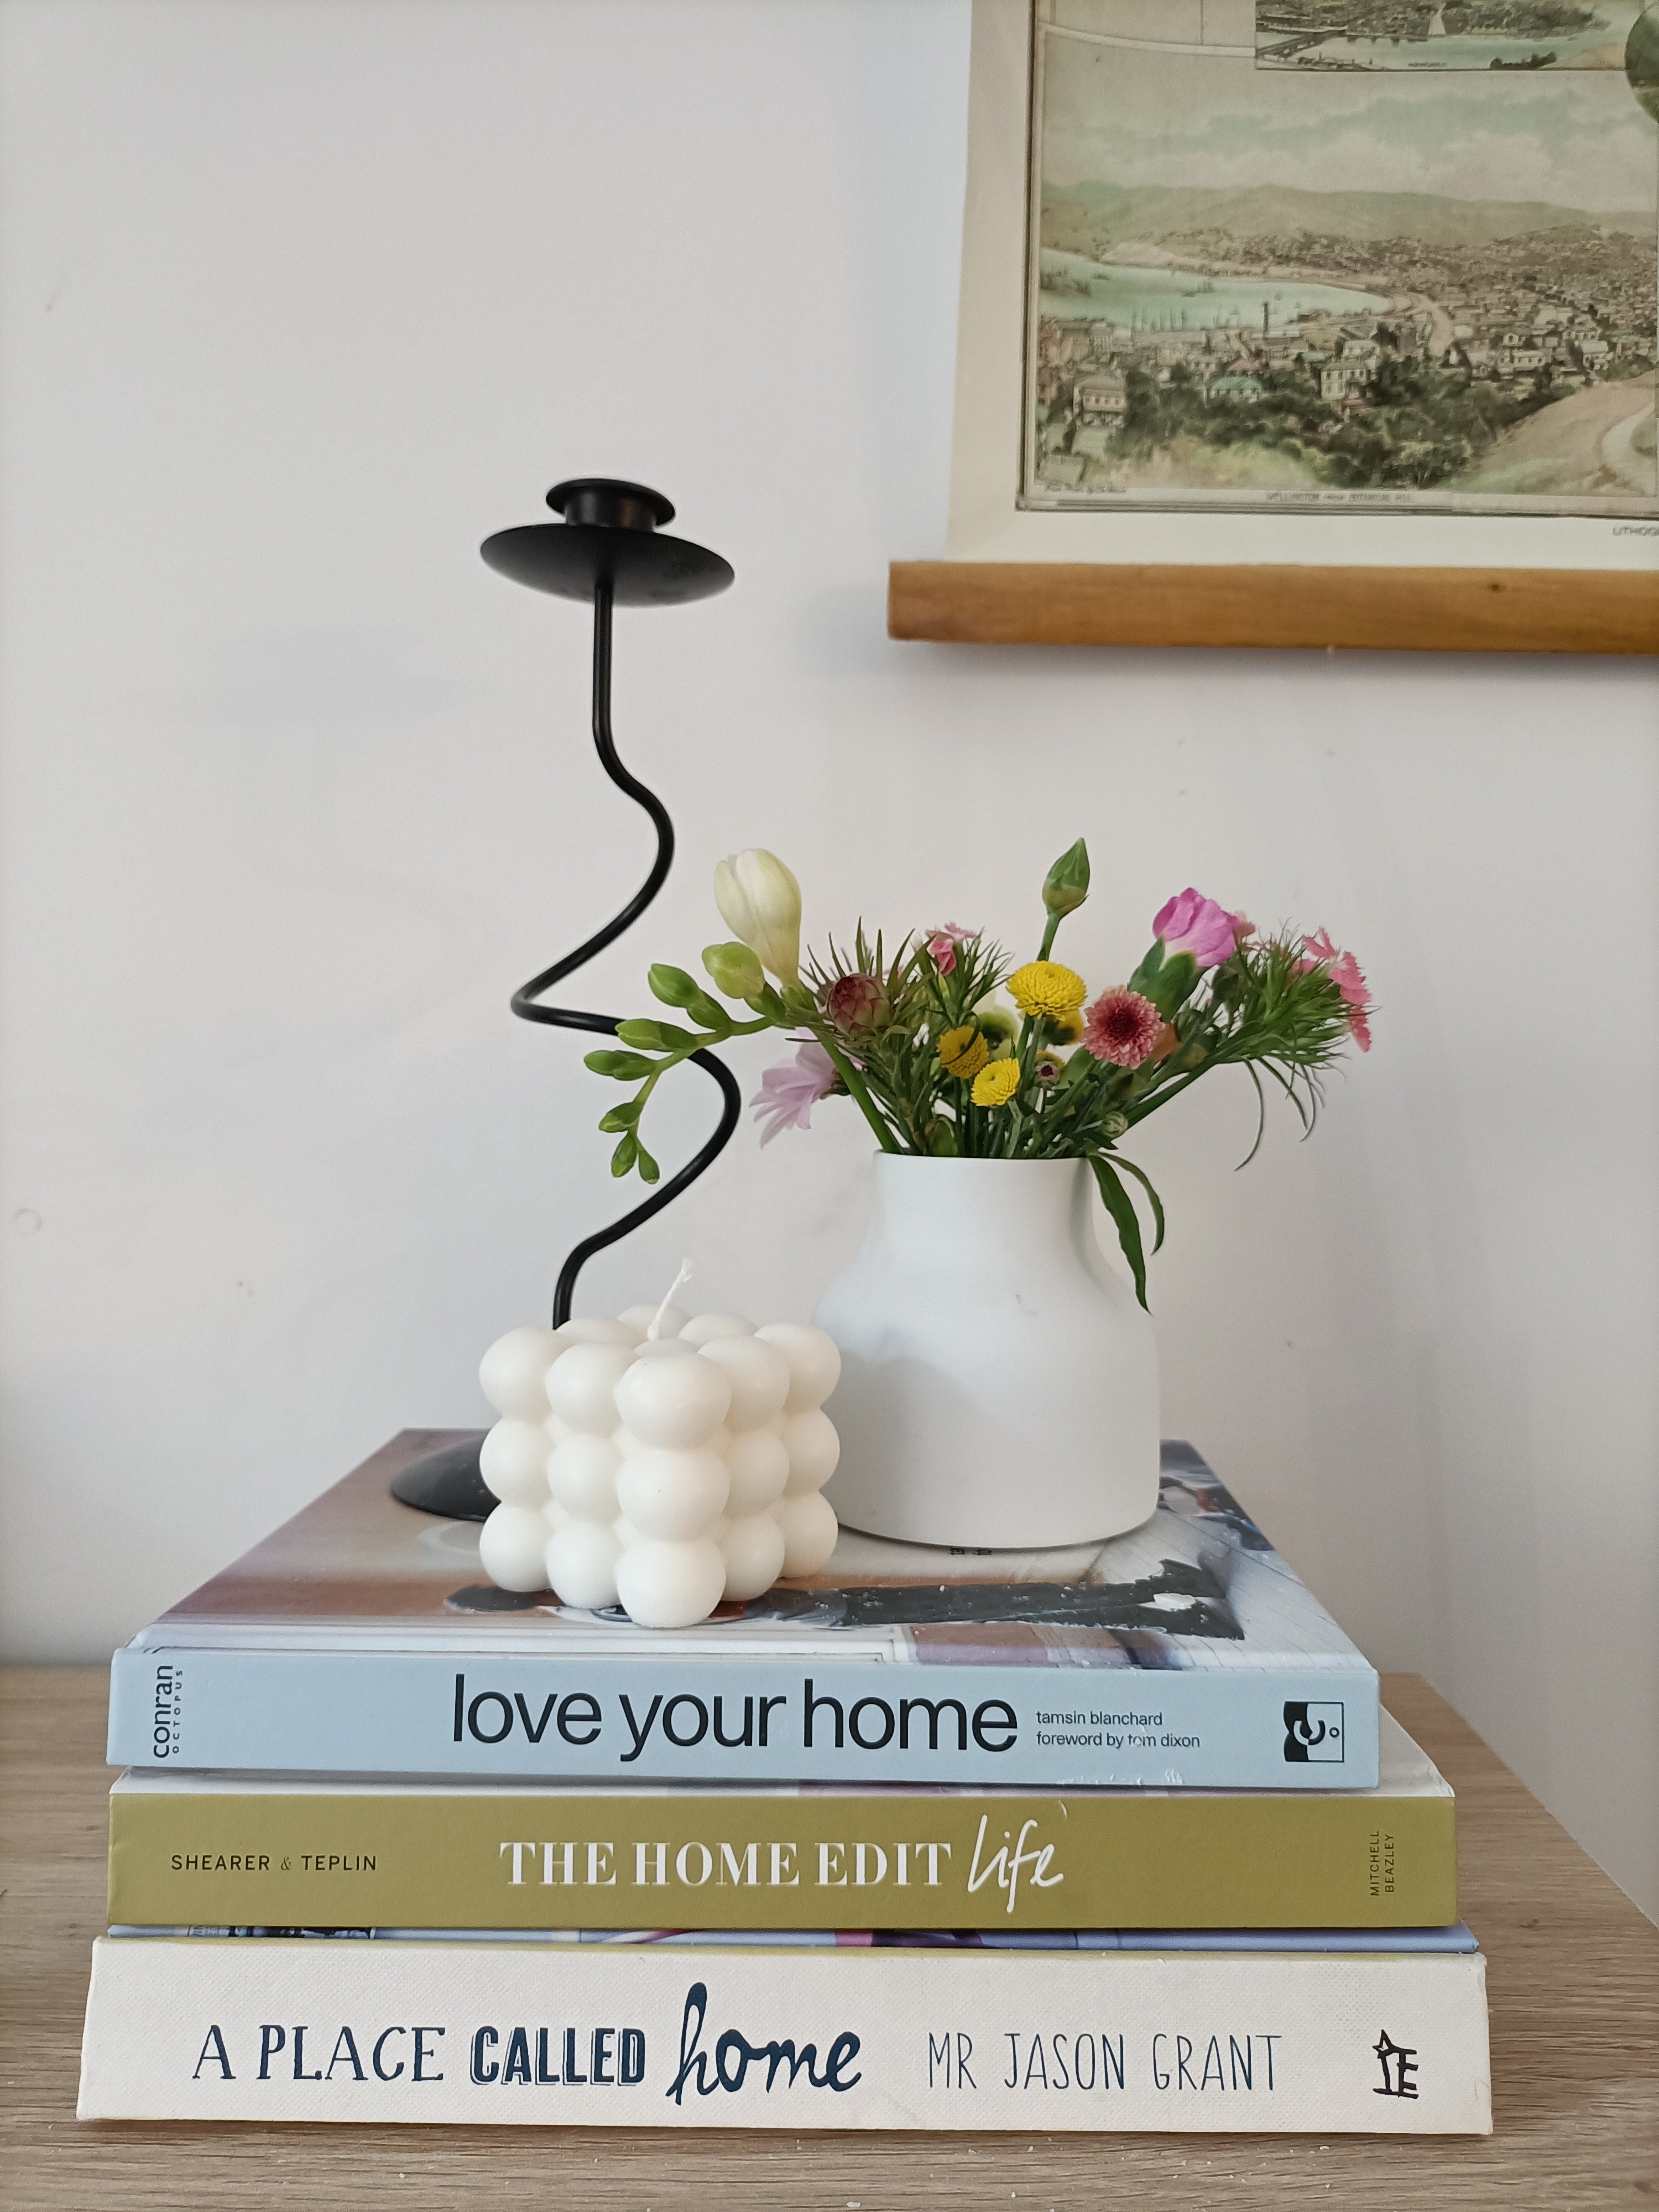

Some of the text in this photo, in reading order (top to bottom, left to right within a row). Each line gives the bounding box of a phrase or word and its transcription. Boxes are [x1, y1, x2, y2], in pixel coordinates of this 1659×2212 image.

[153, 1665, 173, 1759] conran
[172, 1670, 183, 1754] OCTOPUS
[453, 1673, 1019, 1762] love your home
[1036, 1710, 1162, 1726] tamsin blanchard
[1036, 1730, 1103, 1746] foreword
[1107, 1732, 1124, 1749] by
[1160, 1733, 1201, 1747] dixon
[171, 1854, 377, 1871] SHEARER & TEPLIN
[500, 1842, 617, 1886] THE
[632, 1842, 800, 1886] HOME
[814, 1843, 952, 1887] EDIT
[1369, 1830, 1380, 1896] MITCHELL
[1384, 1833, 1395, 1892] BEAZLEY
[192, 1982, 862, 2106] A PLACE CALLED home
[928, 2032, 1283, 2091] MR JASON GRANT
